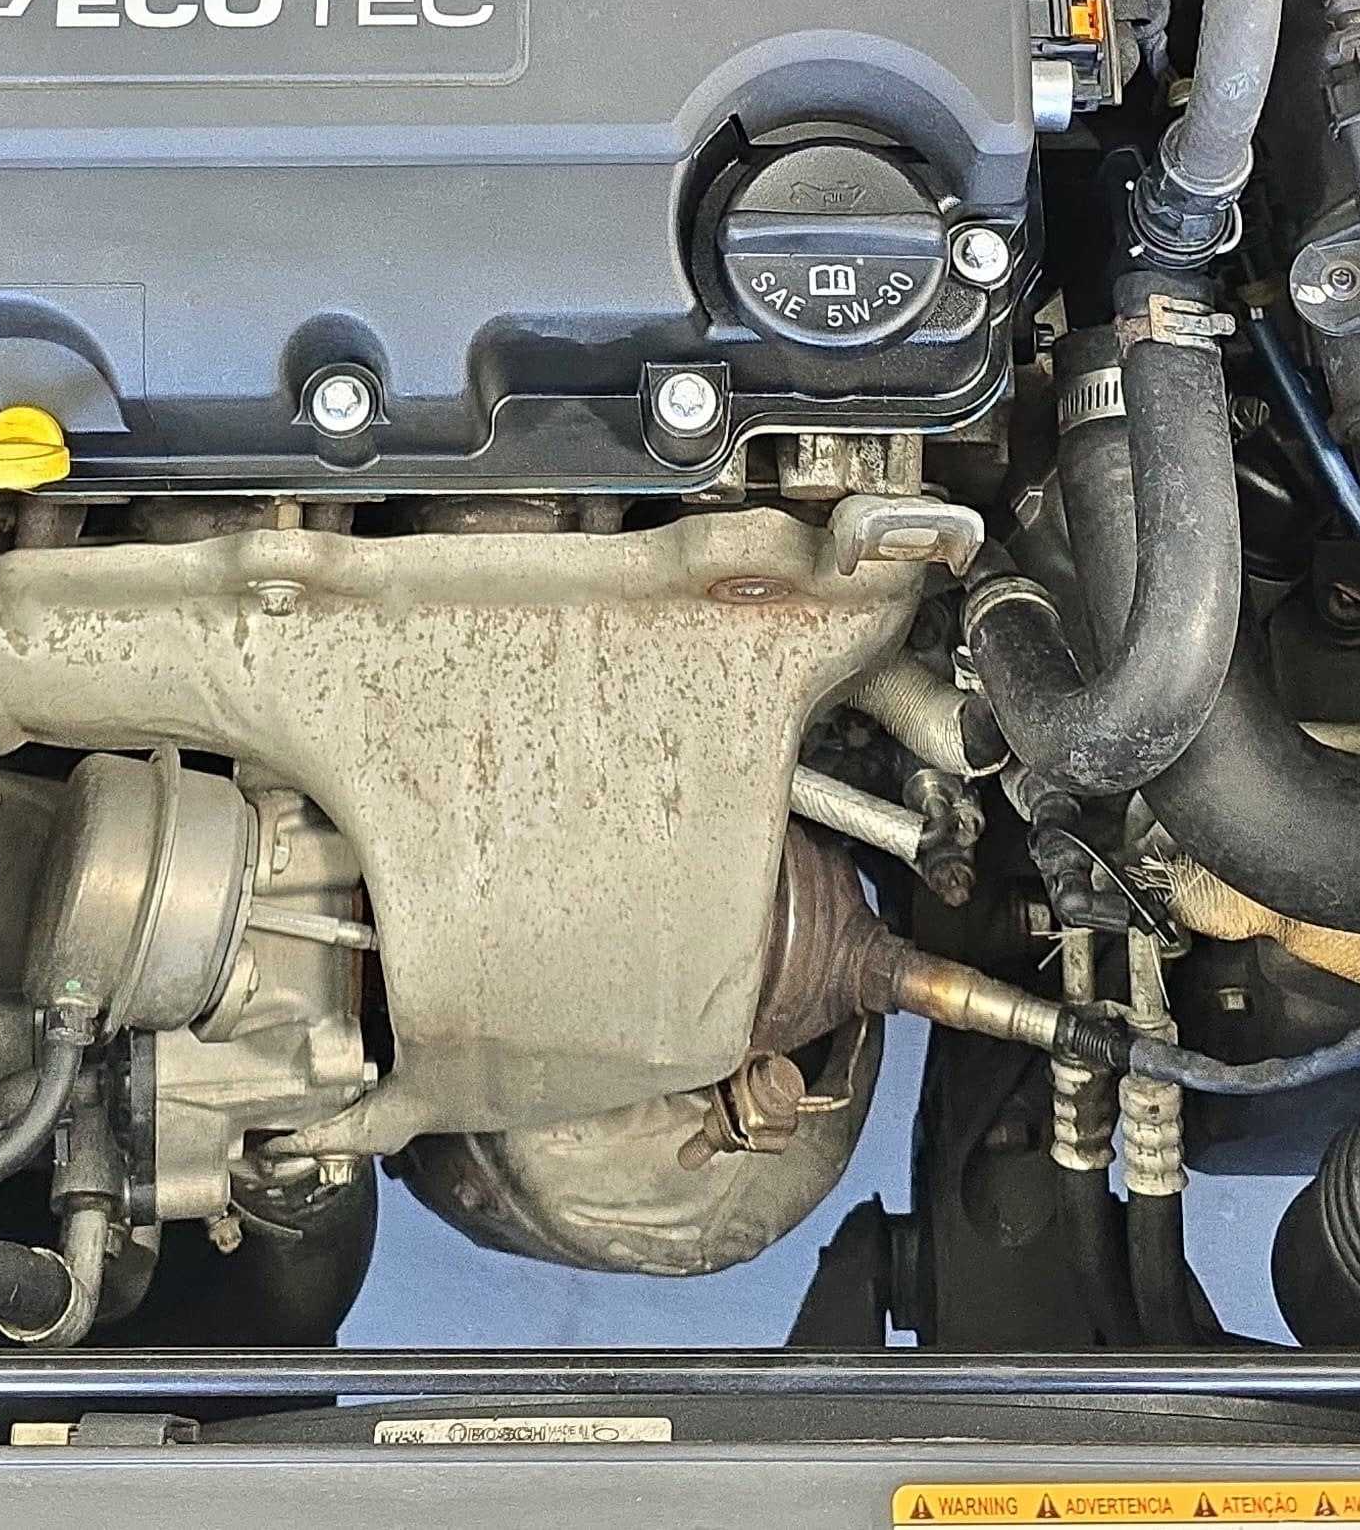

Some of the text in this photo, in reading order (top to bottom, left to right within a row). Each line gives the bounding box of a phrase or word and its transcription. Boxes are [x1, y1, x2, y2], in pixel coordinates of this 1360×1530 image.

[750, 271, 915, 328] SAE 5W-30
[471, 1426, 546, 1441] BOSCH
[937, 1497, 1018, 1515] WARNING
[1065, 1497, 1173, 1515] ADVERTENCIA
[1222, 1493, 1298, 1517] ATENÇÃO
